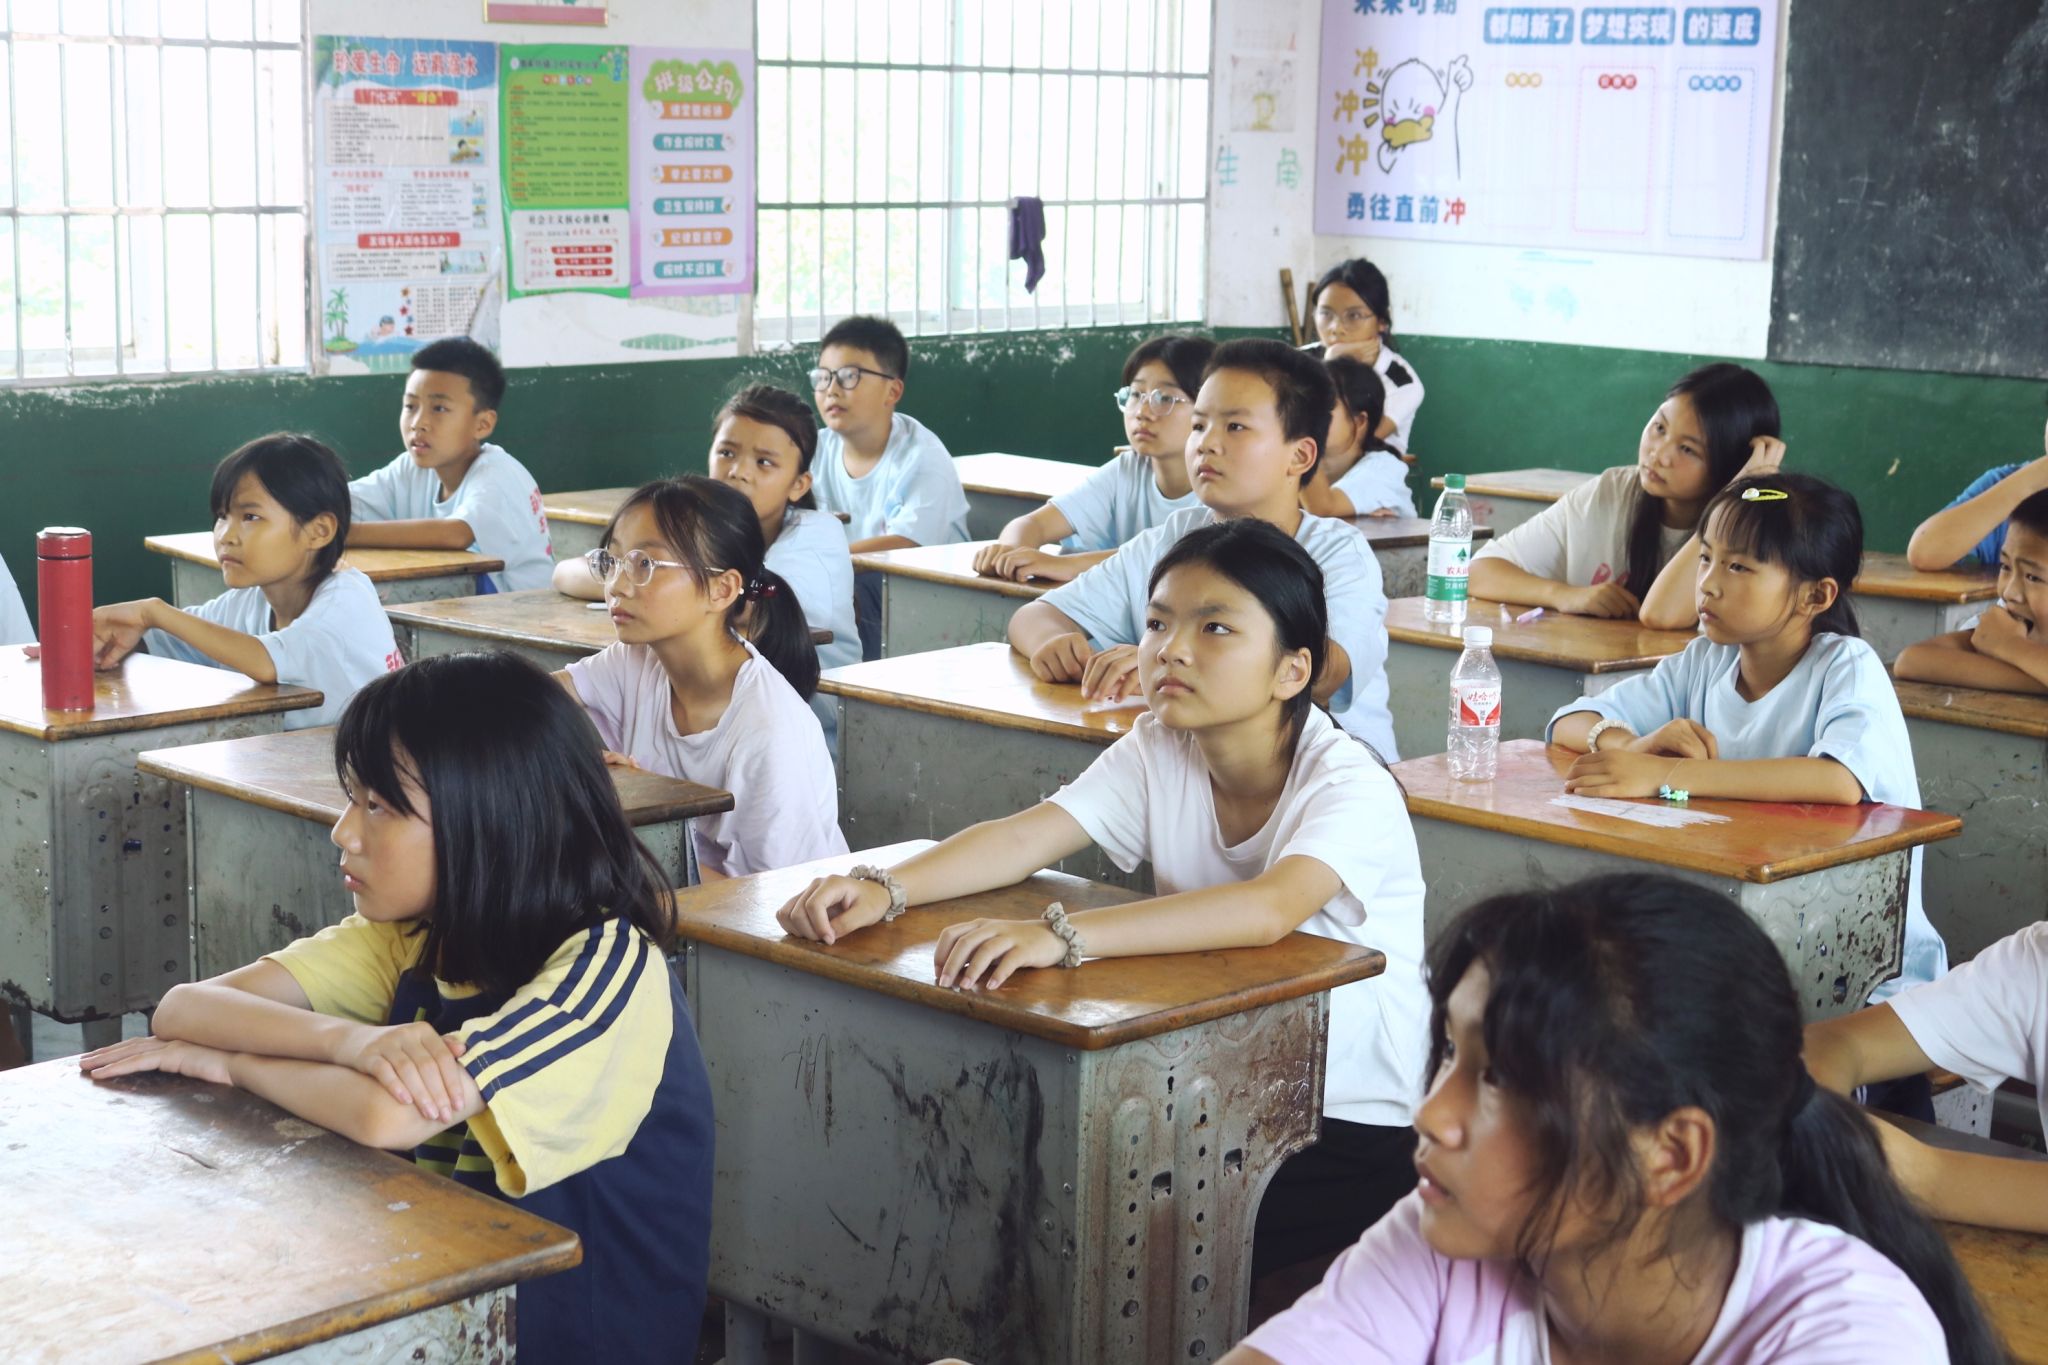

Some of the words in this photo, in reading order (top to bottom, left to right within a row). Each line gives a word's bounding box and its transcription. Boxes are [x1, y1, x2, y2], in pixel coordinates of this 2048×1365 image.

[1489, 13, 1568, 40] 都刷新了
[1585, 13, 1671, 40] 梦想实现
[1688, 14, 1754, 40] 的速度
[334, 51, 400, 75] 珍爱生命
[1354, 46, 1378, 78] 冲
[655, 67, 734, 99] 班级公约
[1333, 89, 1359, 123] 冲
[1335, 133, 1369, 176] 冲
[1347, 192, 1466, 225] 勇往直前冲
